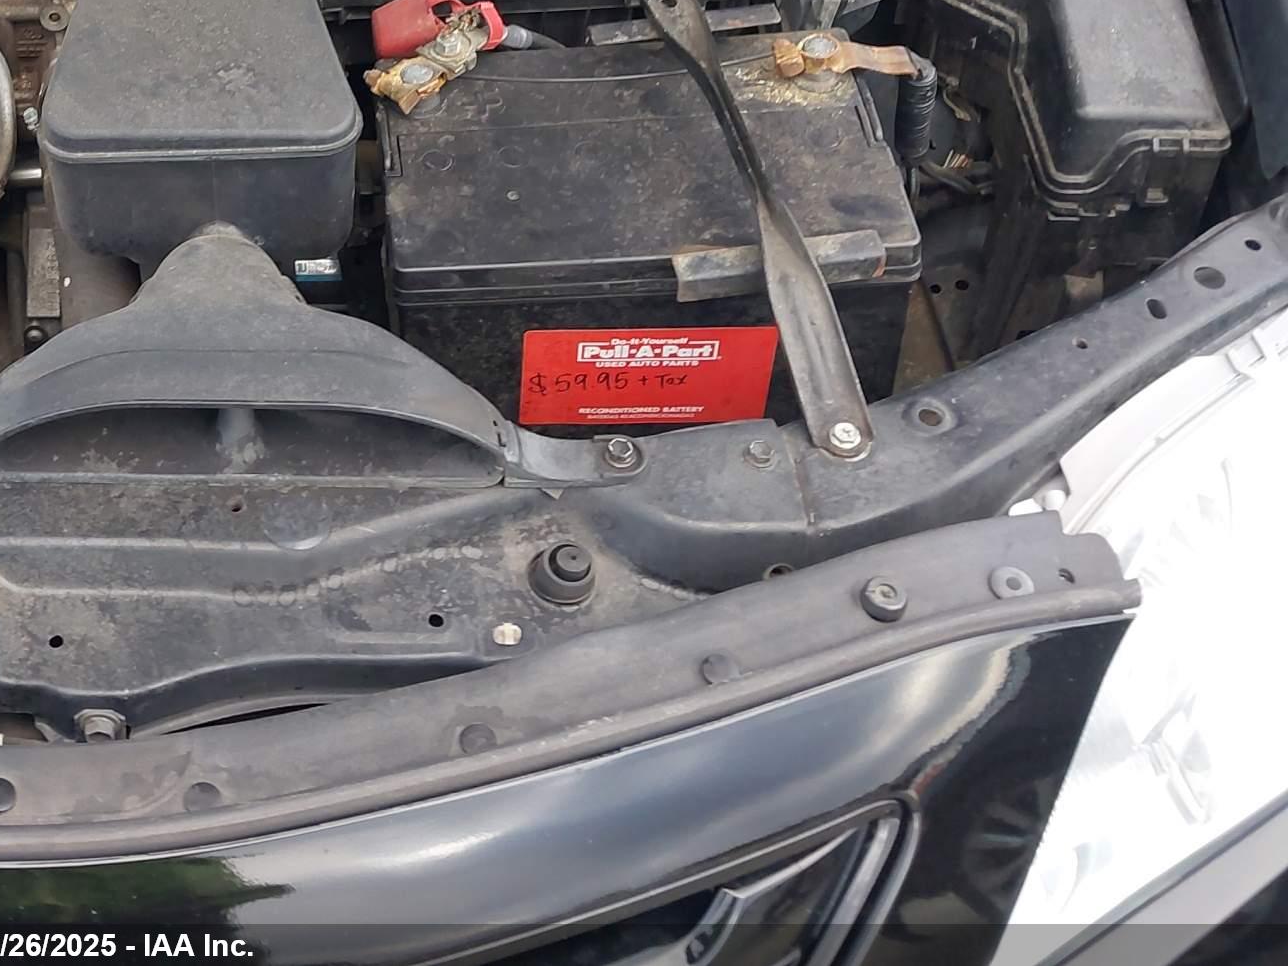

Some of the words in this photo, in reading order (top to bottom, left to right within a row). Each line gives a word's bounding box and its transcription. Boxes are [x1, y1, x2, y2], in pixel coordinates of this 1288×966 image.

[662, 359, 699, 367] PARTS
[578, 406, 661, 414] RECONDITIONED
[662, 405, 704, 413] BATTERY
